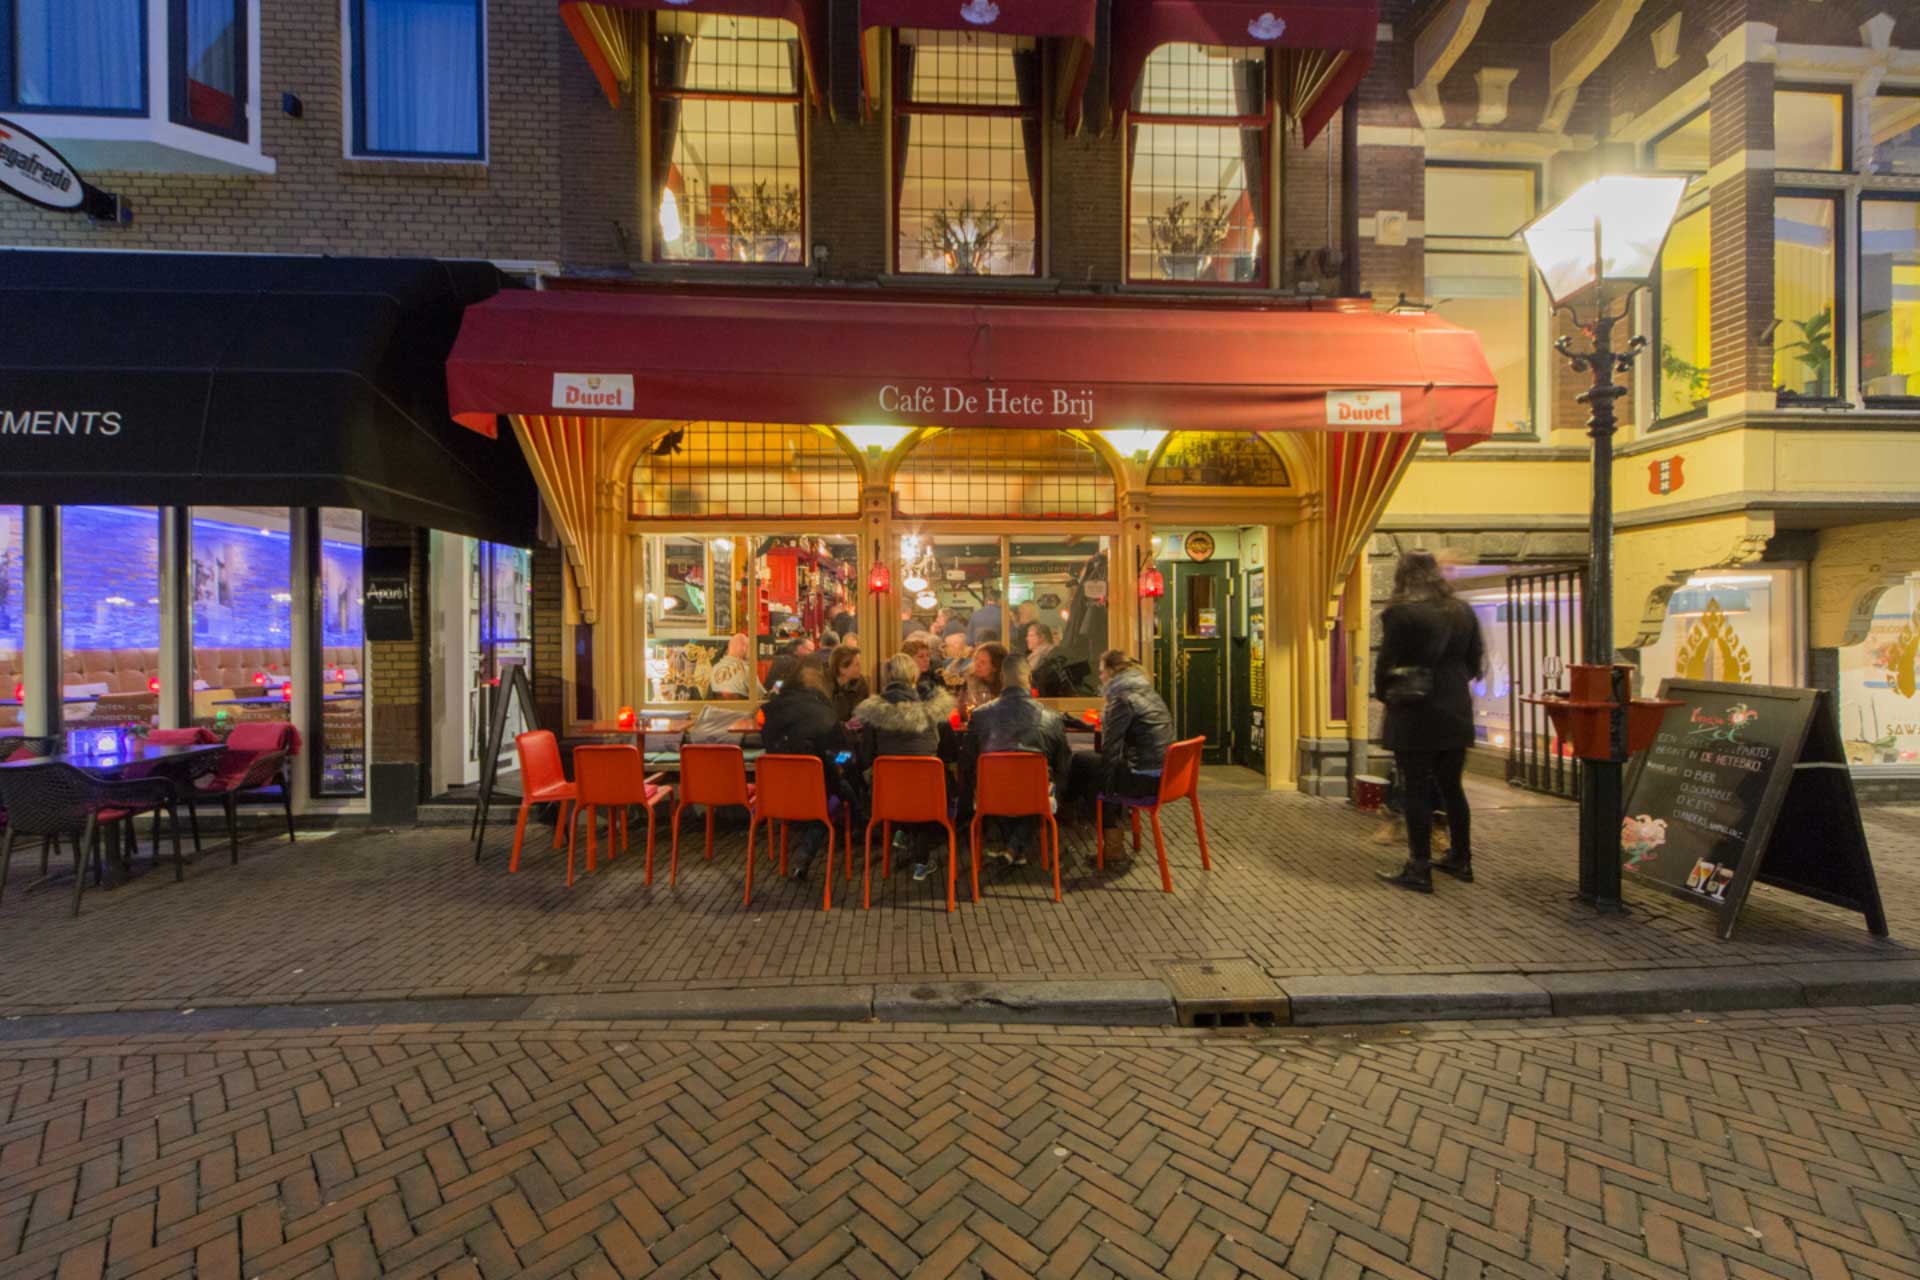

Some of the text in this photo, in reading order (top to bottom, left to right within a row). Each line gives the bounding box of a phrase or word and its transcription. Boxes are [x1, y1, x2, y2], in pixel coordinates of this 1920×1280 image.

[565, 385, 622, 406] Duvel
[879, 384, 1095, 424] Café De Hete Brij
[1337, 401, 1391, 421] Duvel
